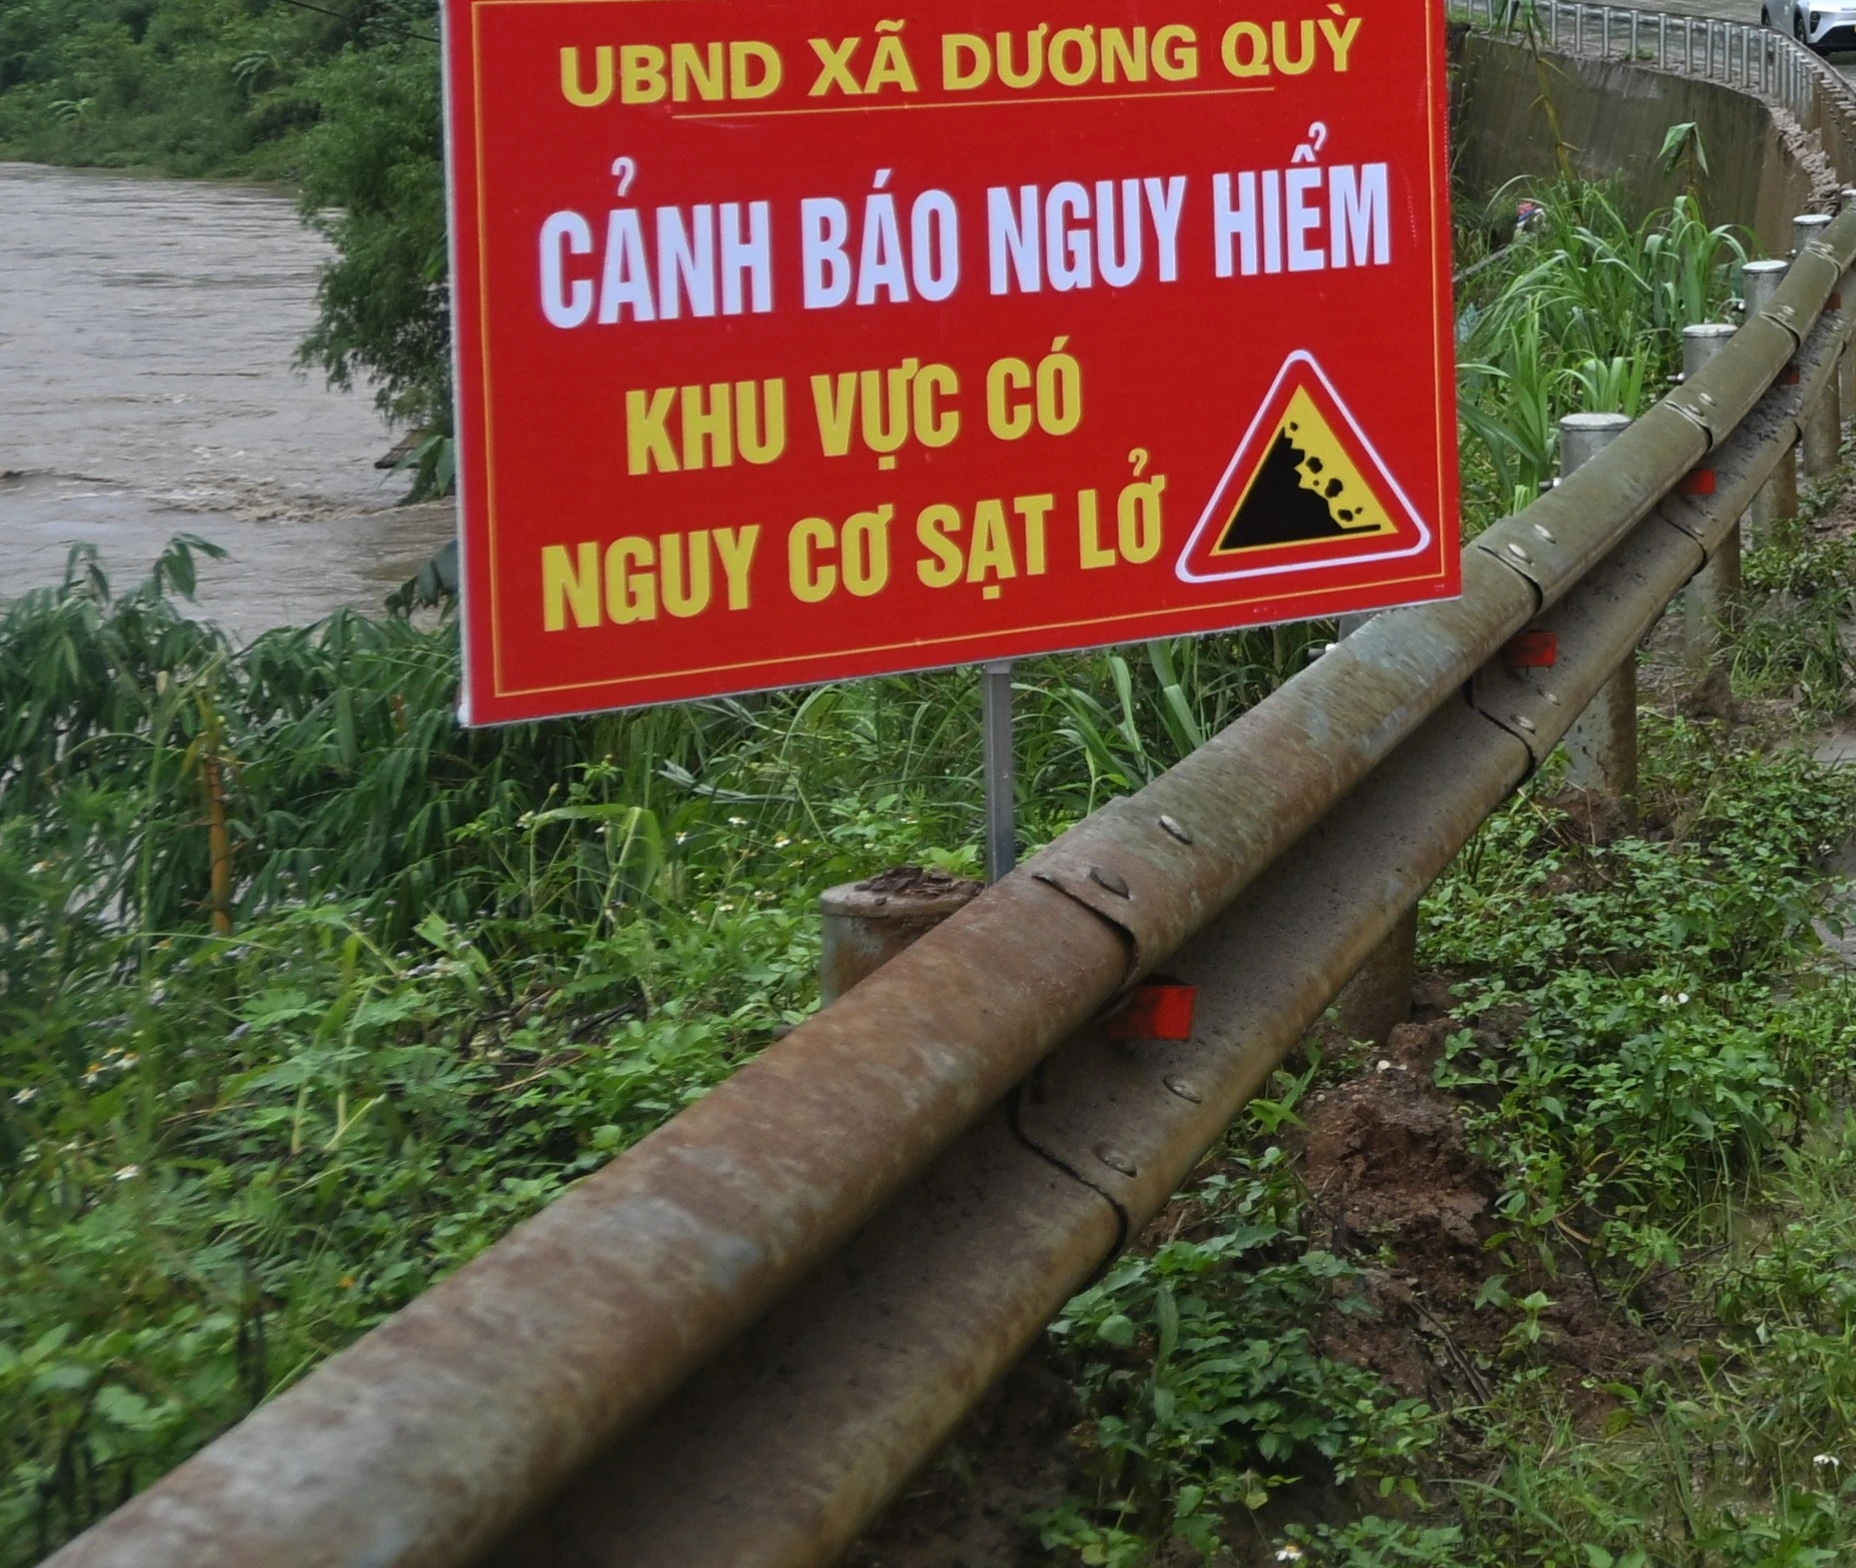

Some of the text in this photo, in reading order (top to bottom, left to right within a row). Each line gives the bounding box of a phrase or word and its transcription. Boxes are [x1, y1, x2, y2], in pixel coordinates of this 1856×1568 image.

[561, 4, 1361, 107] UBND XÃ DƯƠNG QUỲ
[540, 122, 1390, 328] CẢNH BÁO NGUY HIỂM
[626, 336, 1081, 475] KHU VỰC CÓ
[542, 448, 1165, 631] NGUY CƠ SẠT LỞ
